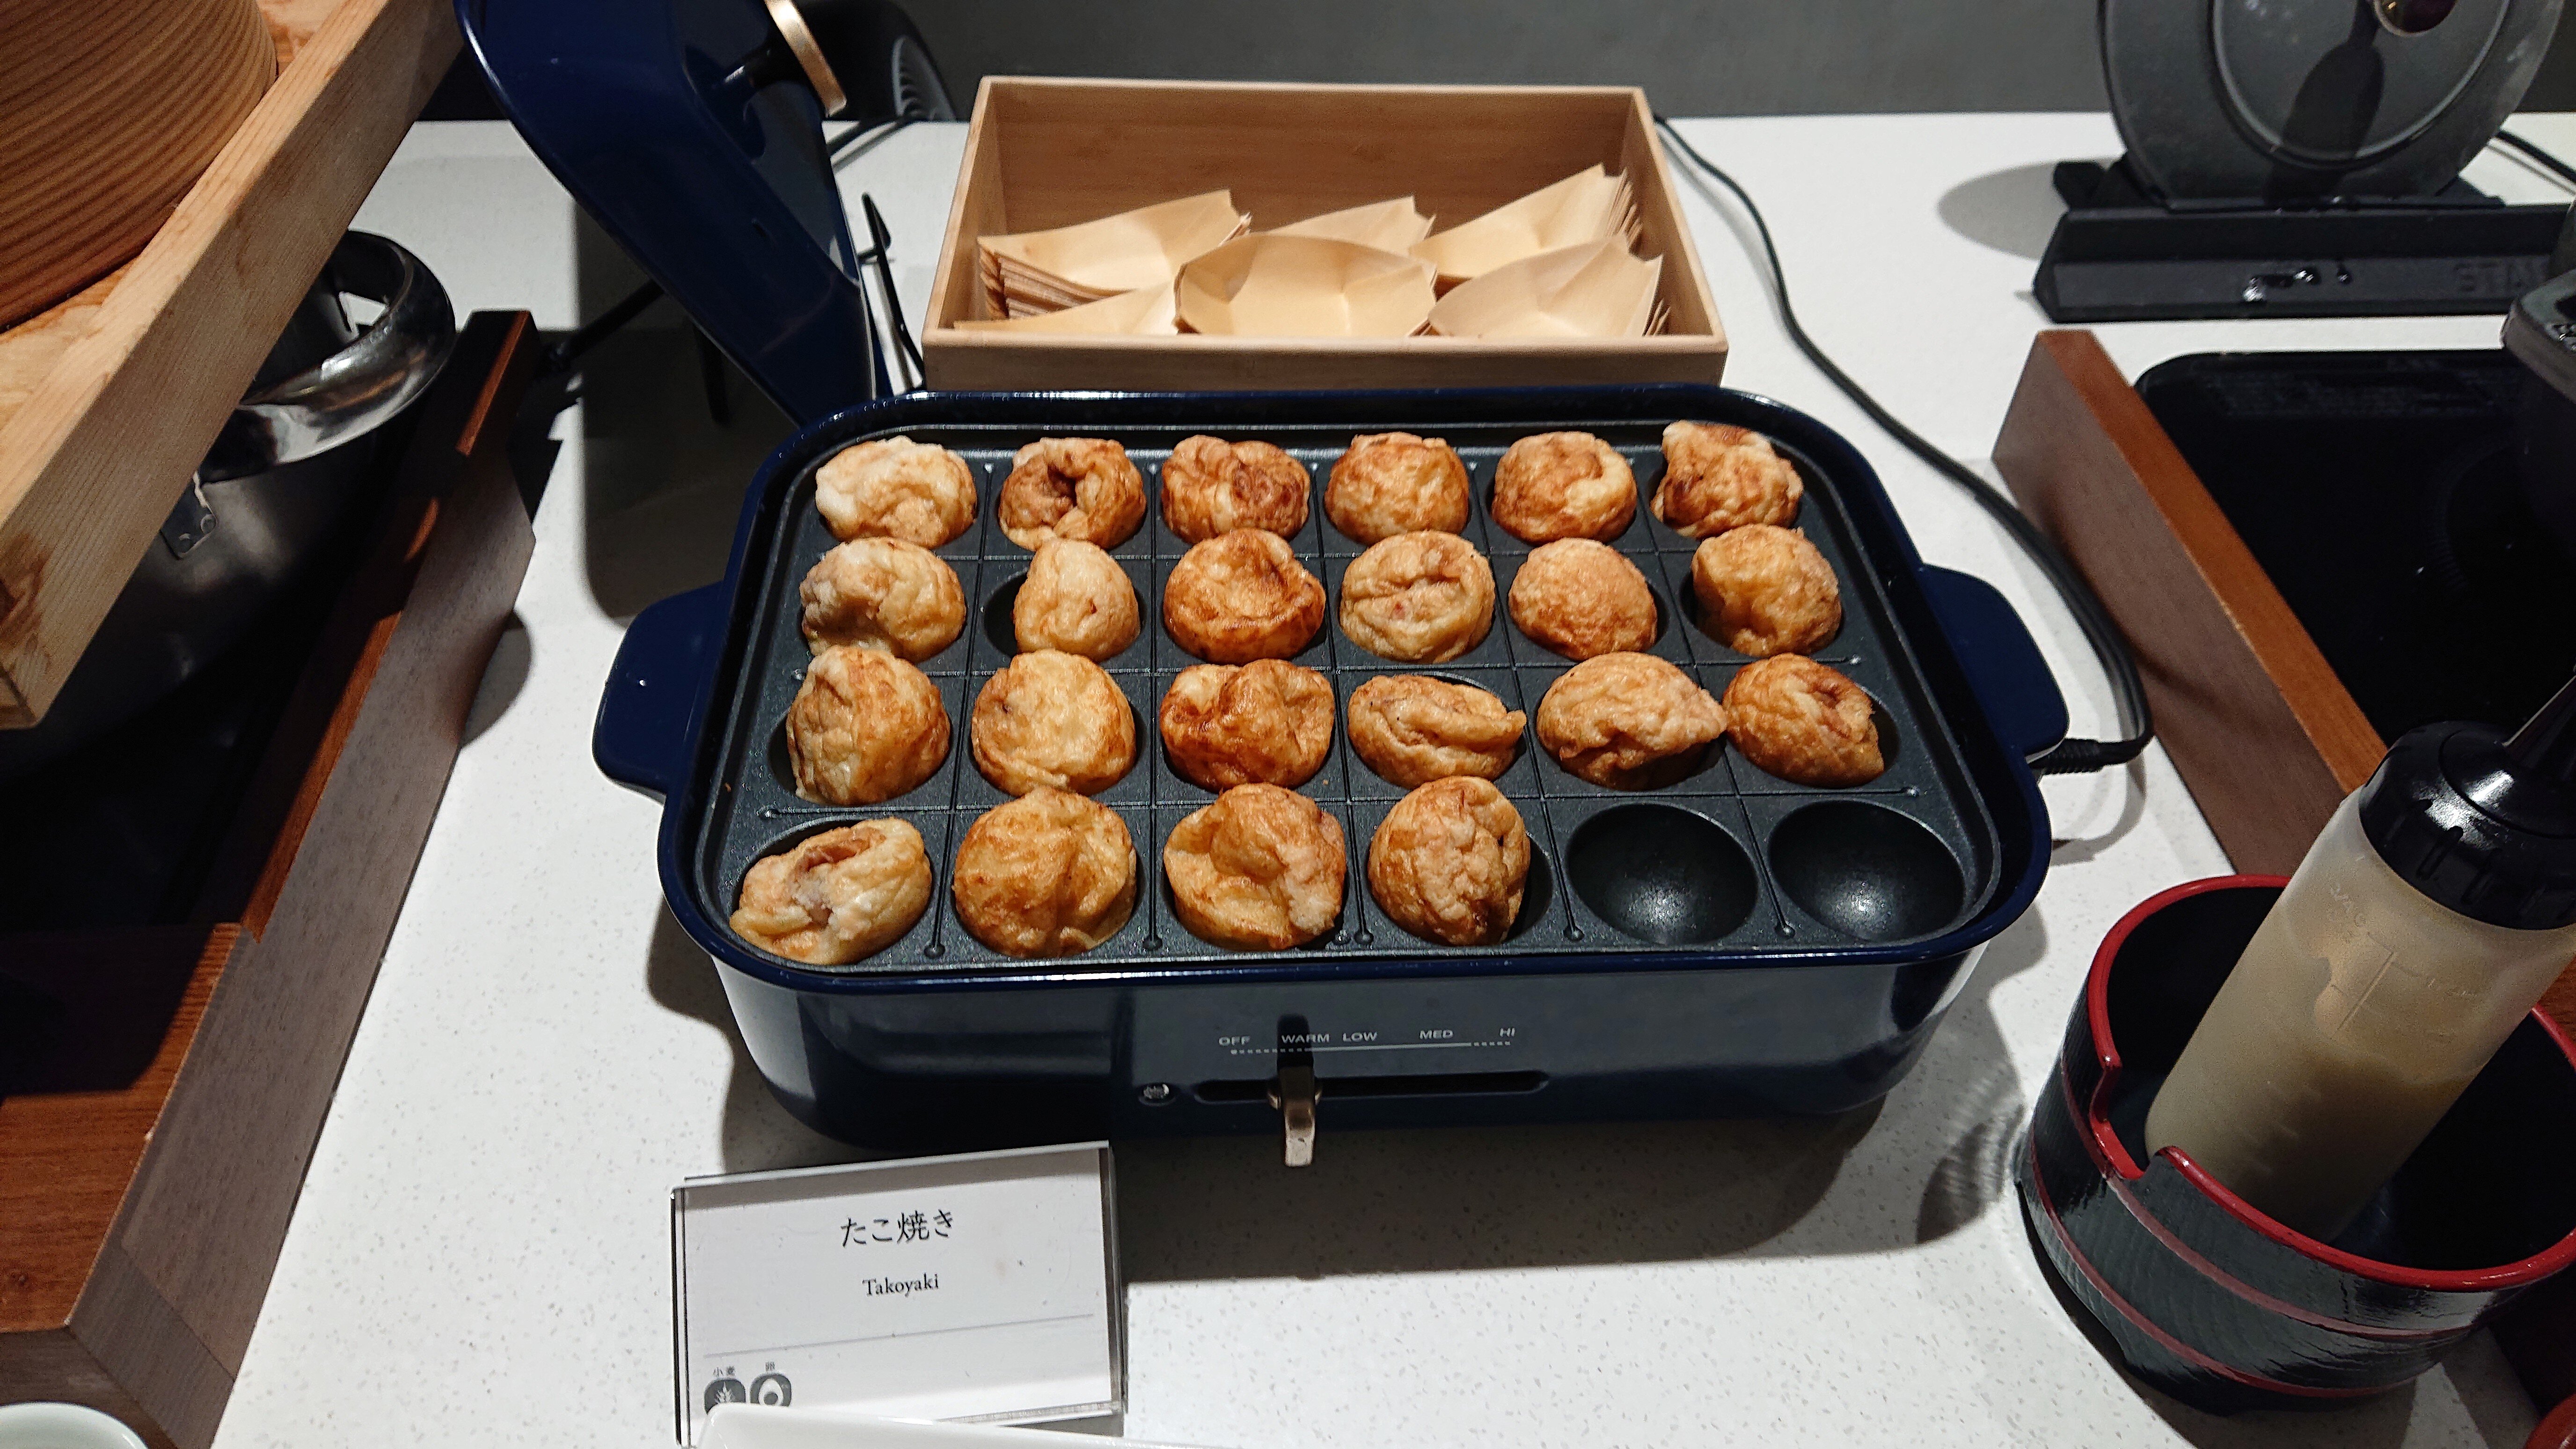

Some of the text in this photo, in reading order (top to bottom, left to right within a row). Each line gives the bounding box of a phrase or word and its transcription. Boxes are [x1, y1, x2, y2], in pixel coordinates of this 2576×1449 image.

[1218, 1027, 1515, 1046] OFF WARM LOW MED HI
[840, 1208, 953, 1248] たこ焼き
[862, 1272, 939, 1298] Takoyaki
